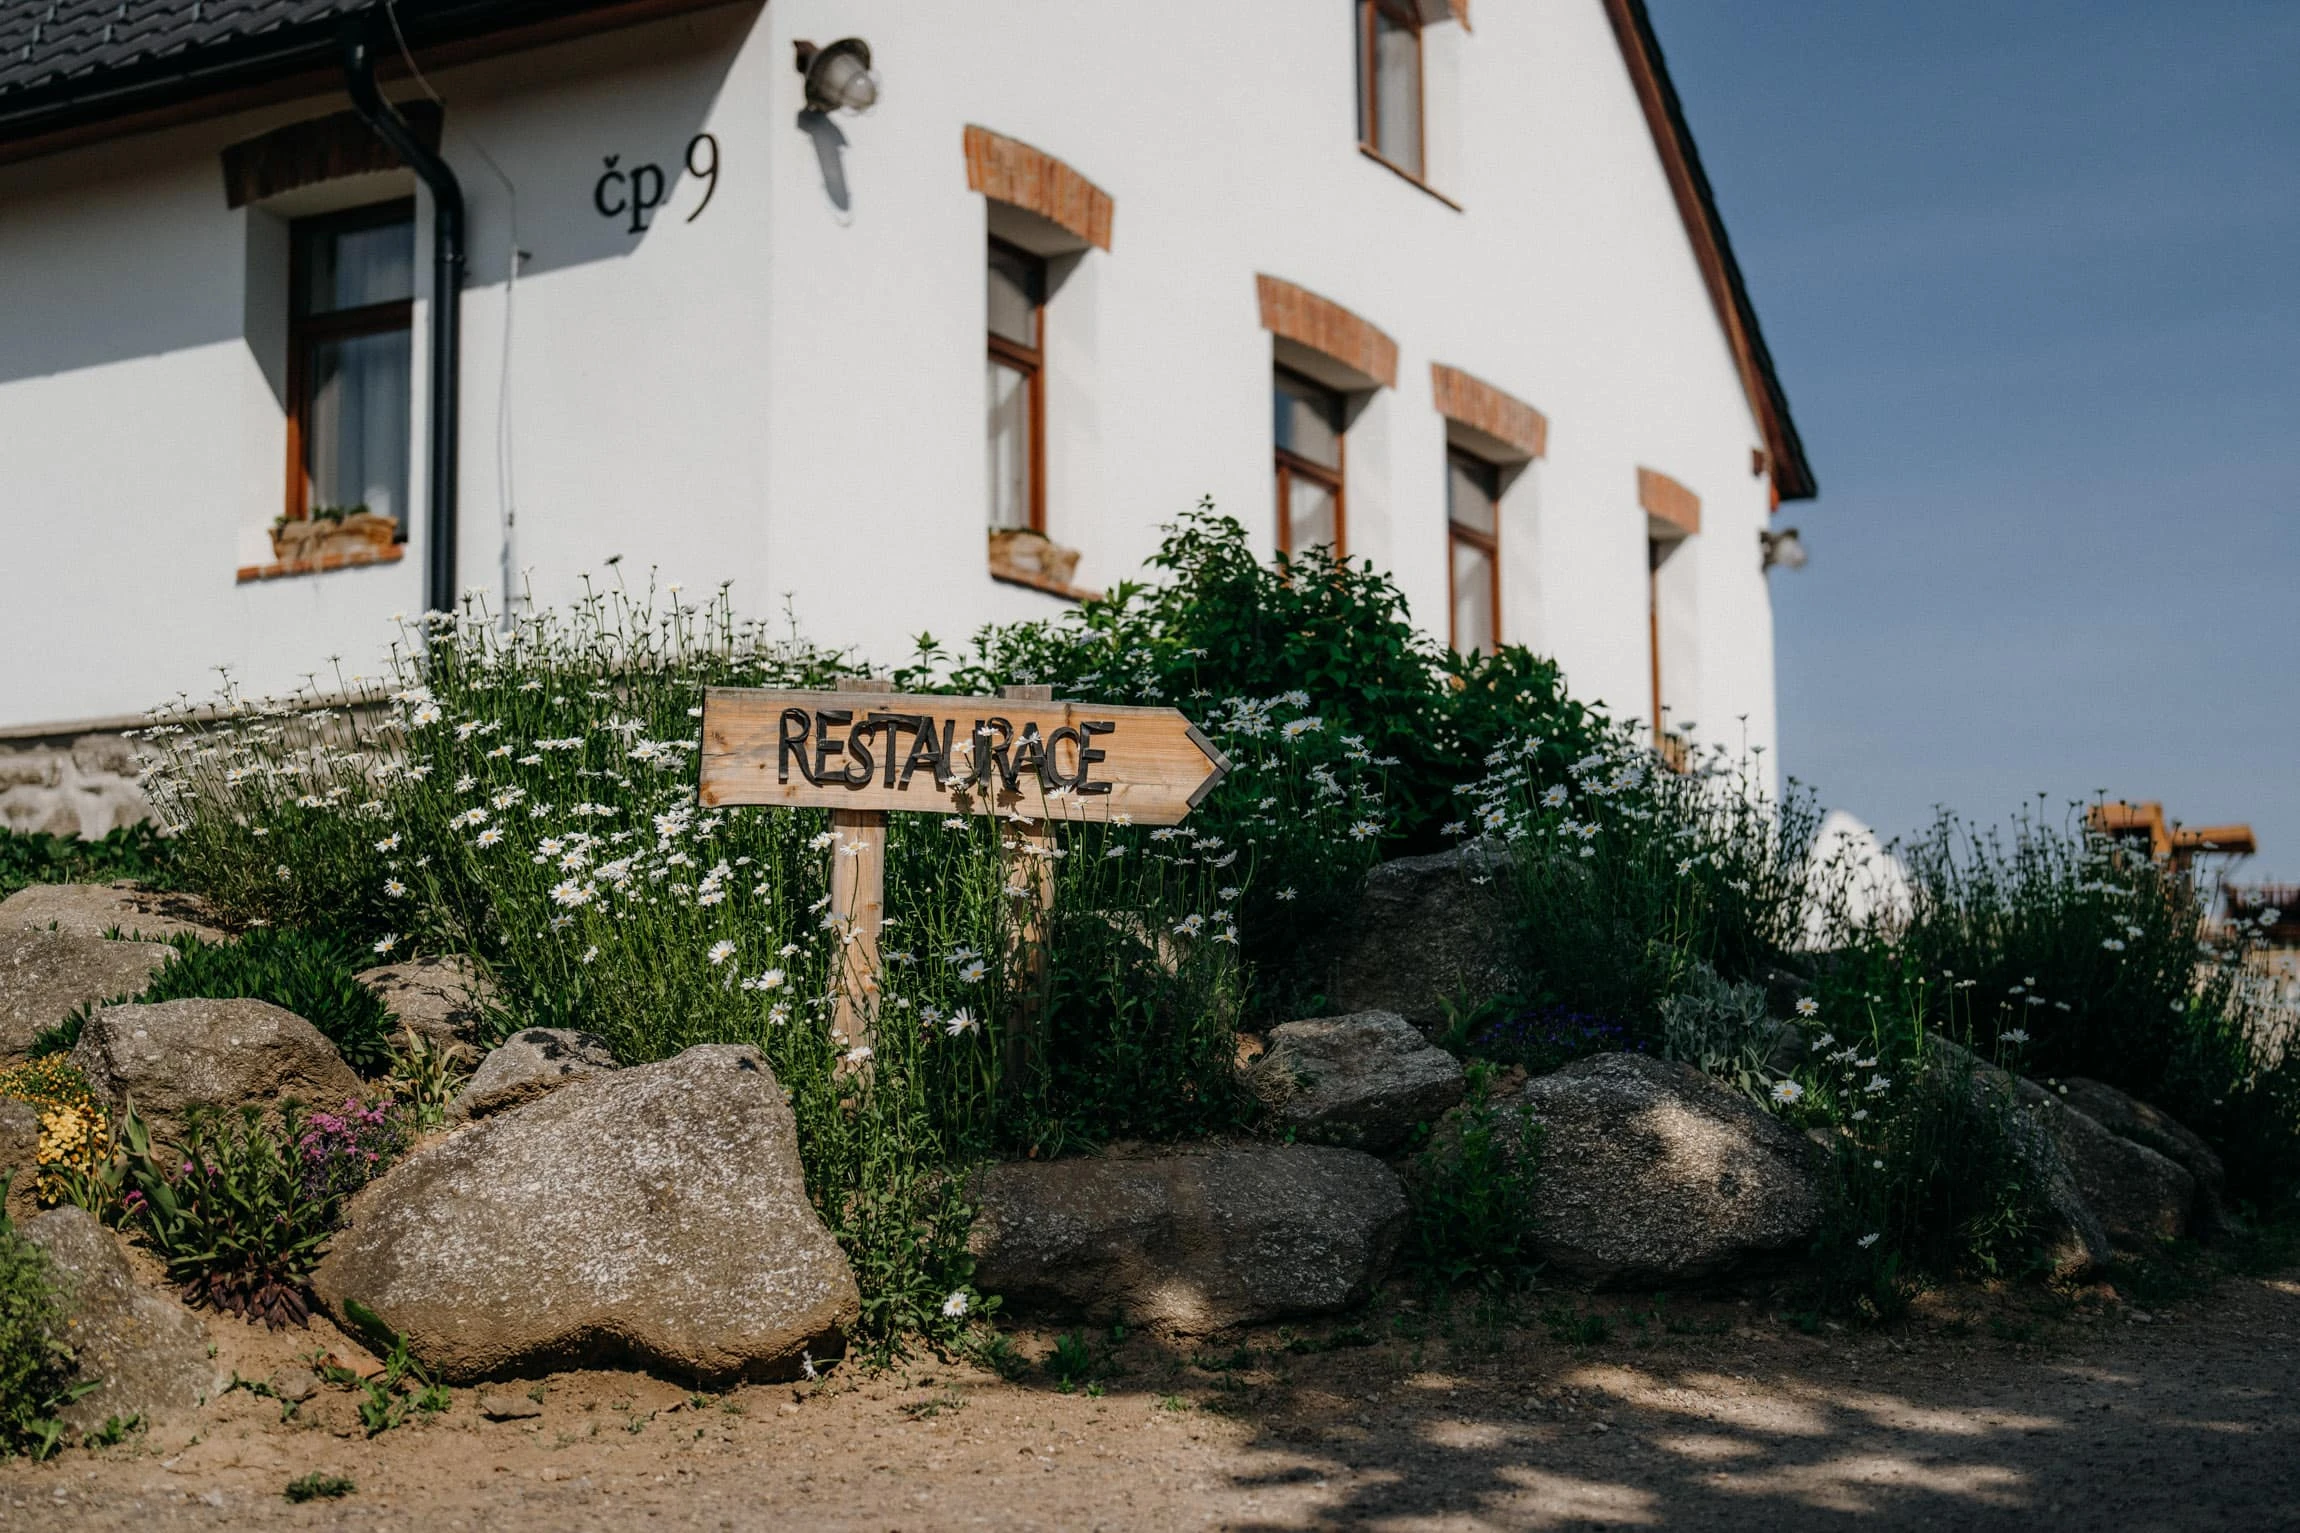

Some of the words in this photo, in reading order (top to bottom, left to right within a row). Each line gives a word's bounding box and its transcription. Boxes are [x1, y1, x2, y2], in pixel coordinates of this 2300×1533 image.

[594, 153, 665, 234] čp
[686, 133, 719, 222] 9
[778, 707, 1115, 795] RESTAURACE
